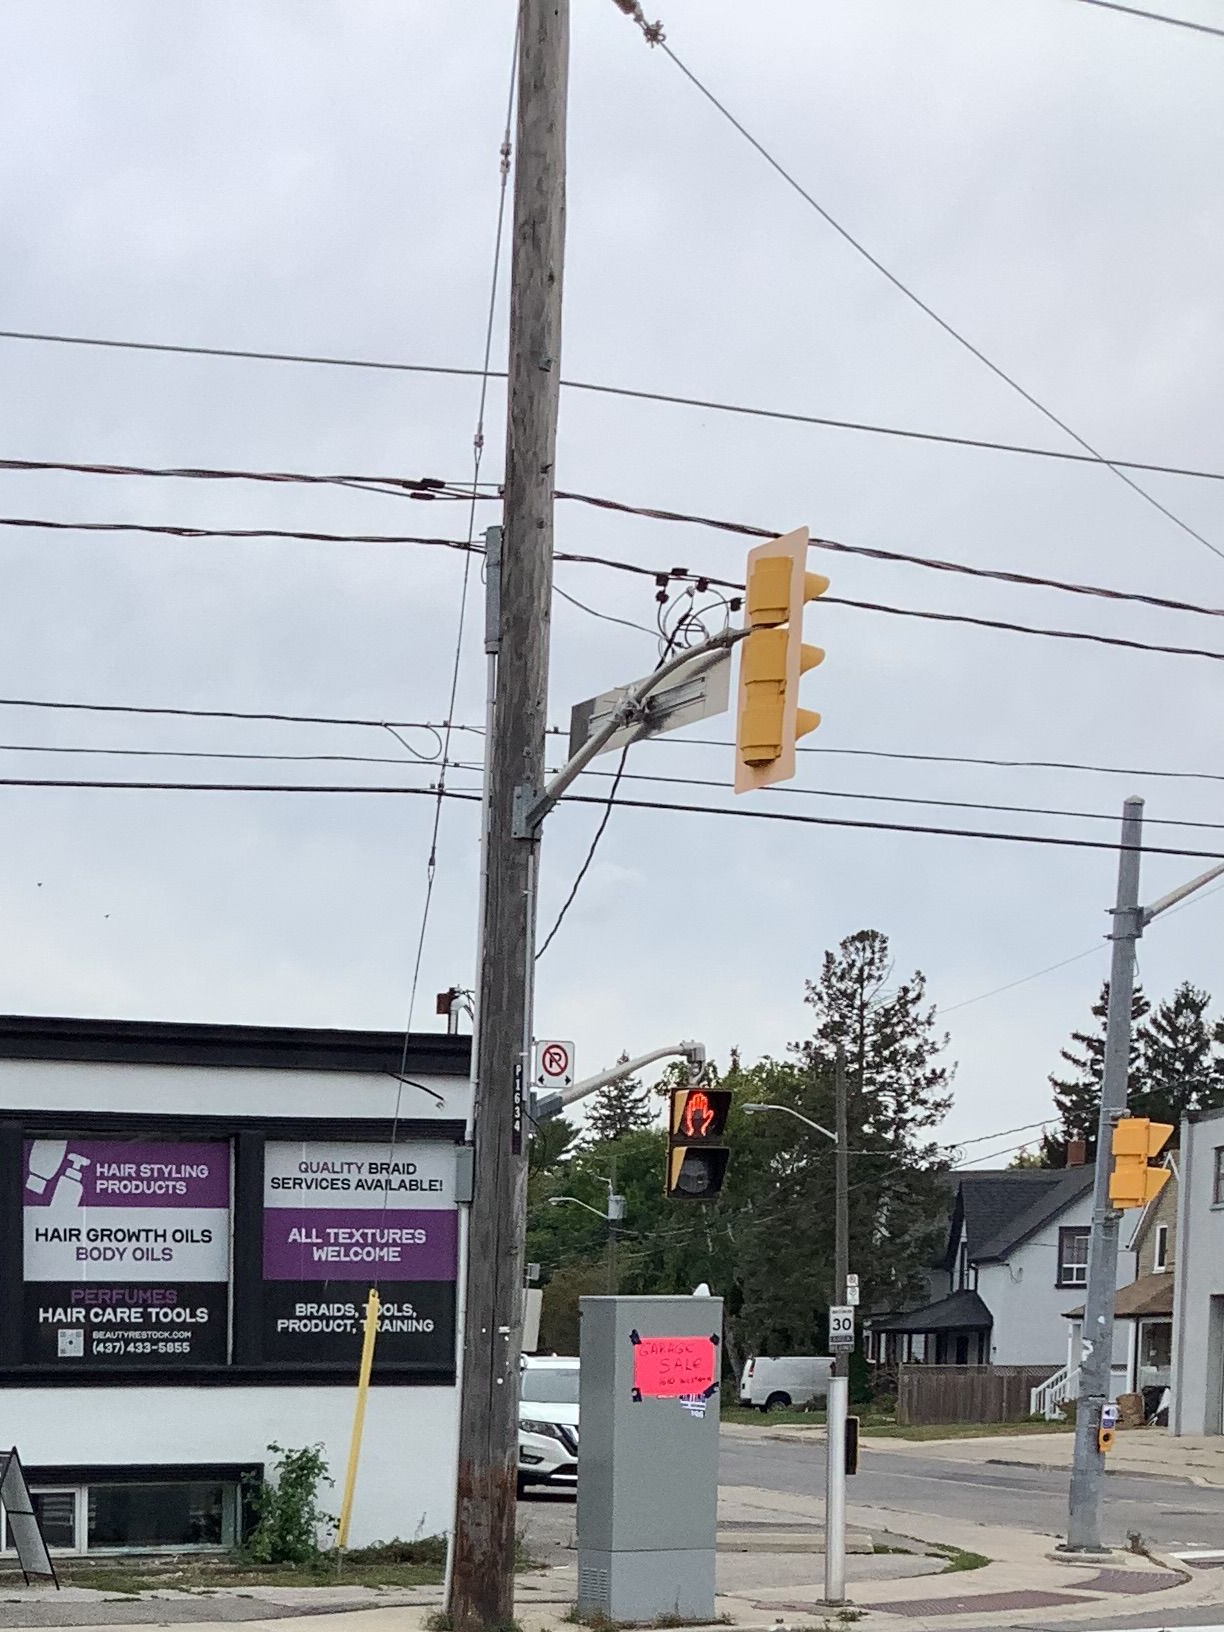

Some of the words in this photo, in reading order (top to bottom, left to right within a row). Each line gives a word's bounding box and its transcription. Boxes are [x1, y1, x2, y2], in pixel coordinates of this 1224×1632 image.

[96, 1163, 135, 1177] HAIR
[140, 1164, 209, 1178] STYLING
[298, 1161, 365, 1174] QUALITY
[368, 1162, 417, 1175] BRAID
[96, 1180, 187, 1194] PRODUCTS
[270, 1178, 351, 1191] SERVICES
[355, 1178, 443, 1192] AVAILABLE!
[35, 1227, 81, 1242] HAIR
[86, 1228, 167, 1243] GROWTH
[172, 1229, 212, 1243] OILS
[288, 1228, 323, 1243] ALL
[326, 1228, 427, 1244] TEXTURES
[76, 1247, 128, 1261] BODY
[132, 1247, 173, 1261] OILS
[312, 1247, 402, 1261] WELCOME
[71, 1289, 178, 1304] PERFUMES
[39, 1308, 86, 1323] HAIR
[90, 1308, 143, 1323] CARE
[147, 1308, 209, 1323] TOOLS
[295, 1303, 359, 1318] BRAIDS,
[277, 1319, 357, 1334] PRODUCT,
[832, 1318, 852, 1331] 30
[92, 1330, 191, 1339] BEAUTYRESTOCK.COM
[92, 1340, 125, 1355] (437)
